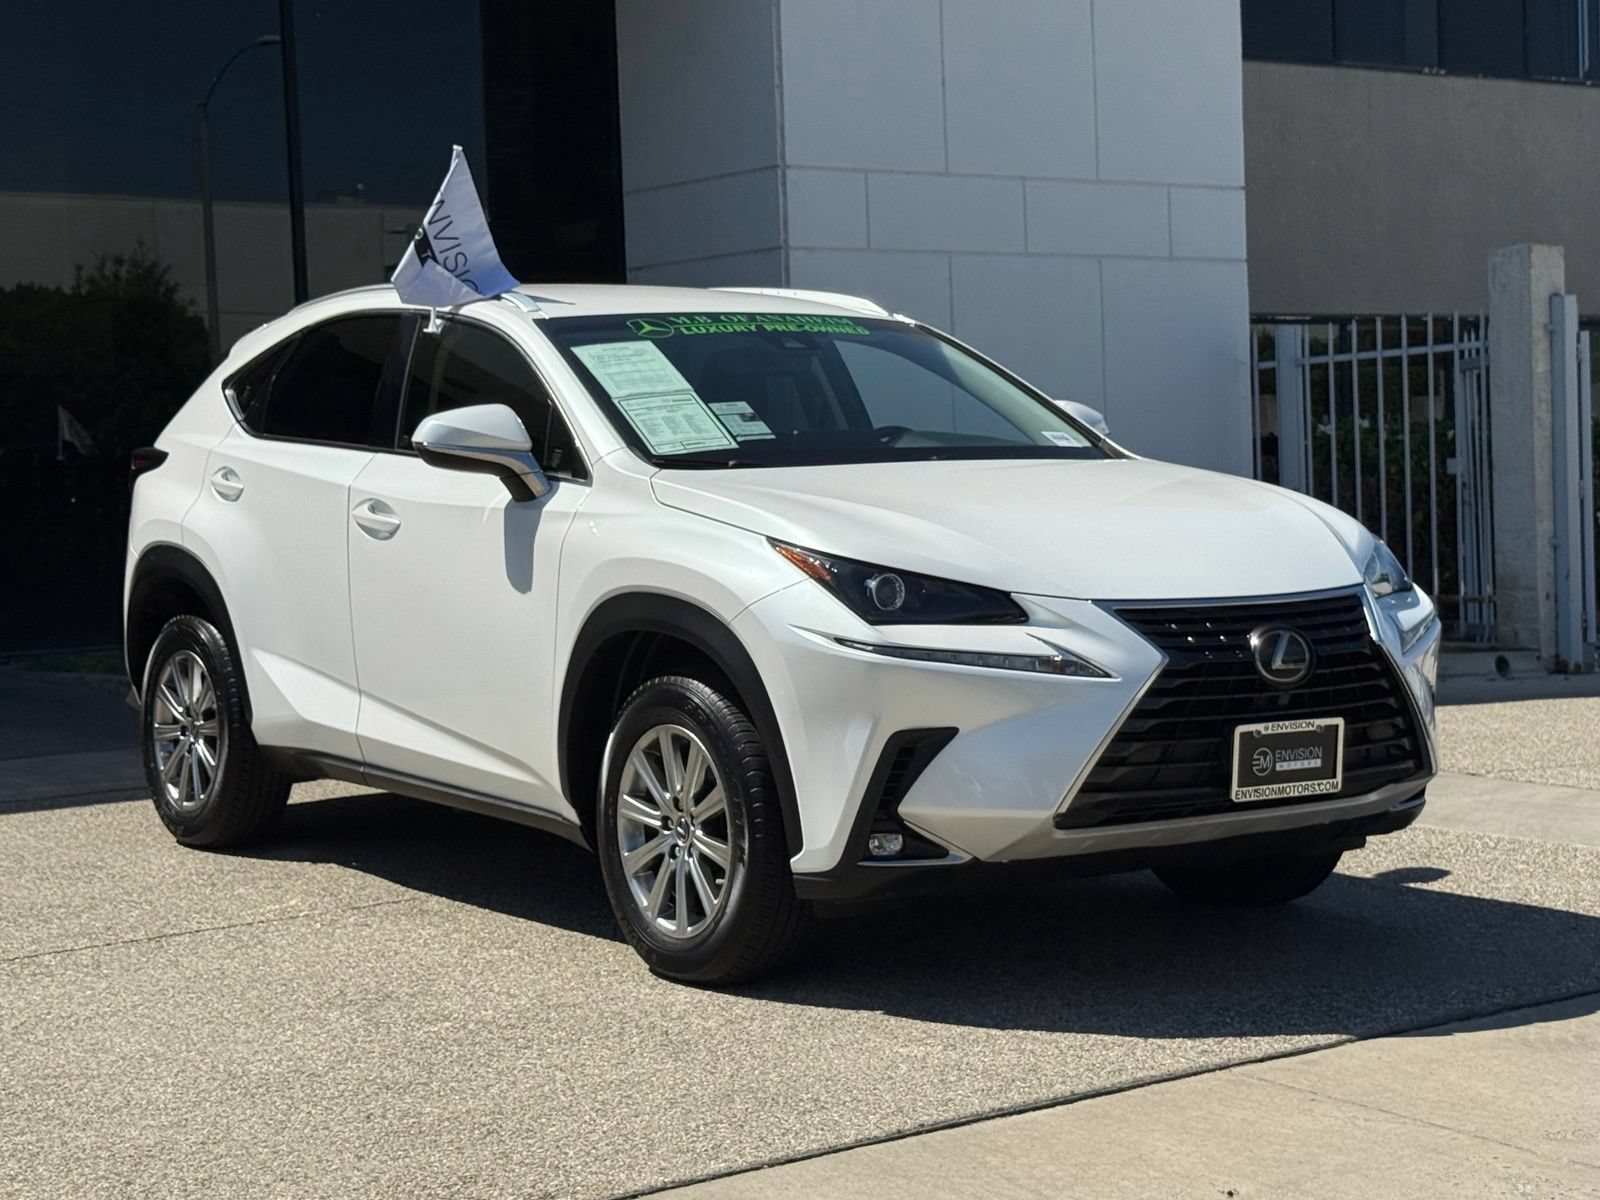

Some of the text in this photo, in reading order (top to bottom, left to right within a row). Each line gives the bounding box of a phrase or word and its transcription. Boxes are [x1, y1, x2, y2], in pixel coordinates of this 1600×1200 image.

[756, 314, 854, 325] ANAHEIM
[679, 323, 870, 335] LUXURY PRE-OWNED
[1270, 720, 1315, 732] ENVISION
[1275, 746, 1323, 761] ENVISION
[1235, 781, 1339, 800] ENVISIONMOTORS.COM
